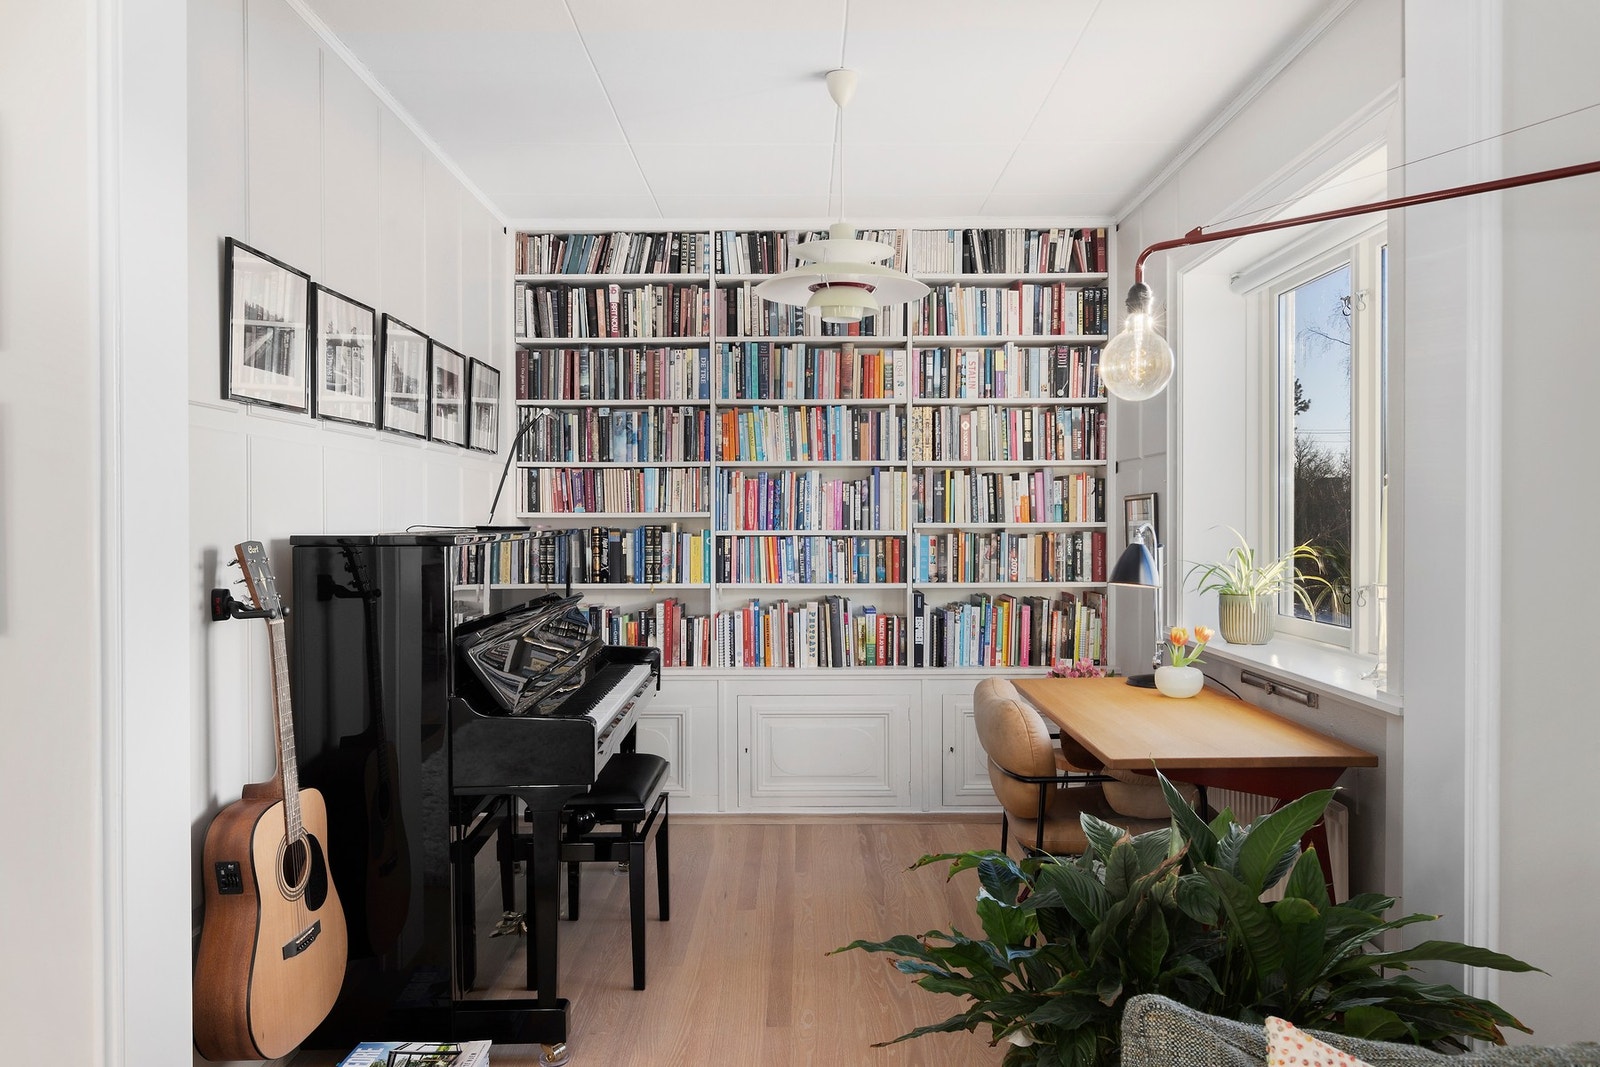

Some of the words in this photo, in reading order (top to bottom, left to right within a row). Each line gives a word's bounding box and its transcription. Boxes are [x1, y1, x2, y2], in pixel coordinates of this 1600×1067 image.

[611, 303, 619, 316] ART
[611, 316, 619, 333] NOW
[700, 357, 707, 367] DE
[894, 356, 905, 377] 1Q84
[968, 360, 977, 390] STALIN
[1010, 557, 1018, 575] 2070
[808, 611, 817, 658] PHOTOART
